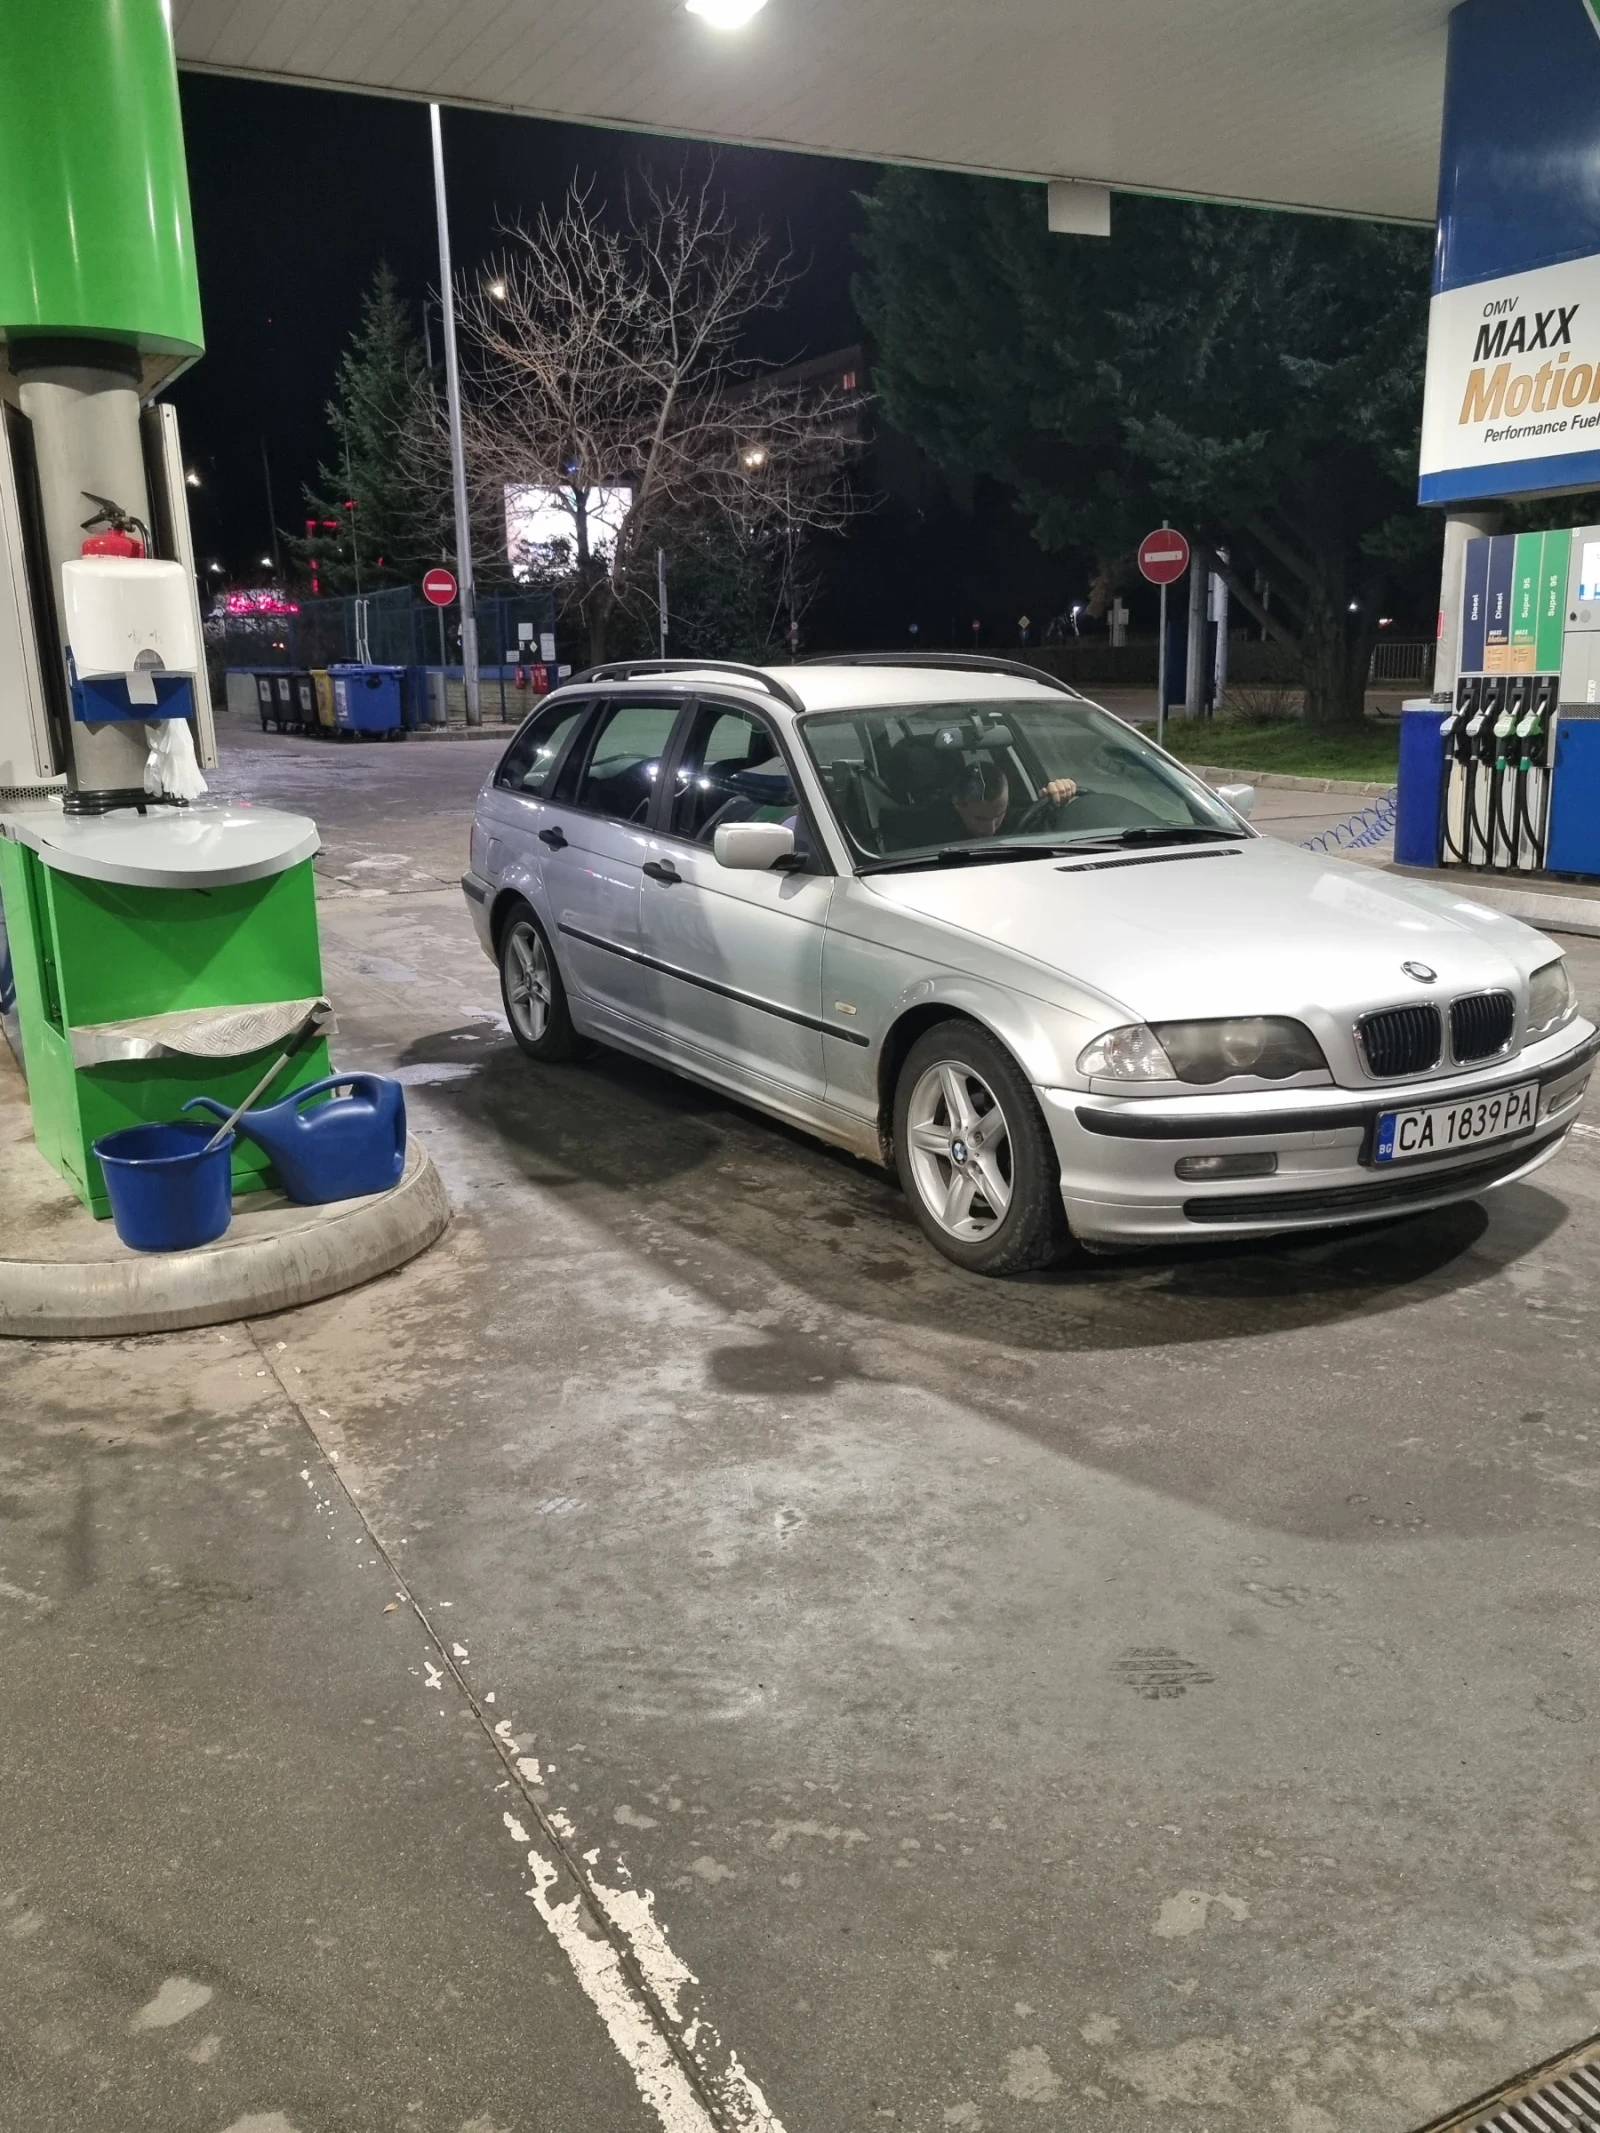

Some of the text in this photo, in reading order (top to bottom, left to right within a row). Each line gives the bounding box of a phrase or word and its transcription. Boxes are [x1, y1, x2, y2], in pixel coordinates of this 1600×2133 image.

[1483, 296, 1519, 317] OMV
[1473, 304, 1580, 362] MAXX
[1484, 420, 1568, 443] Performance
[1471, 594, 1479, 621] Diesel
[1495, 592, 1503, 619] Diesel
[1522, 577, 1531, 618] Super 95
[1548, 575, 1558, 617] Super 95
[1399, 1115, 1434, 1151] CA
[1379, 1143, 1392, 1154] BG
